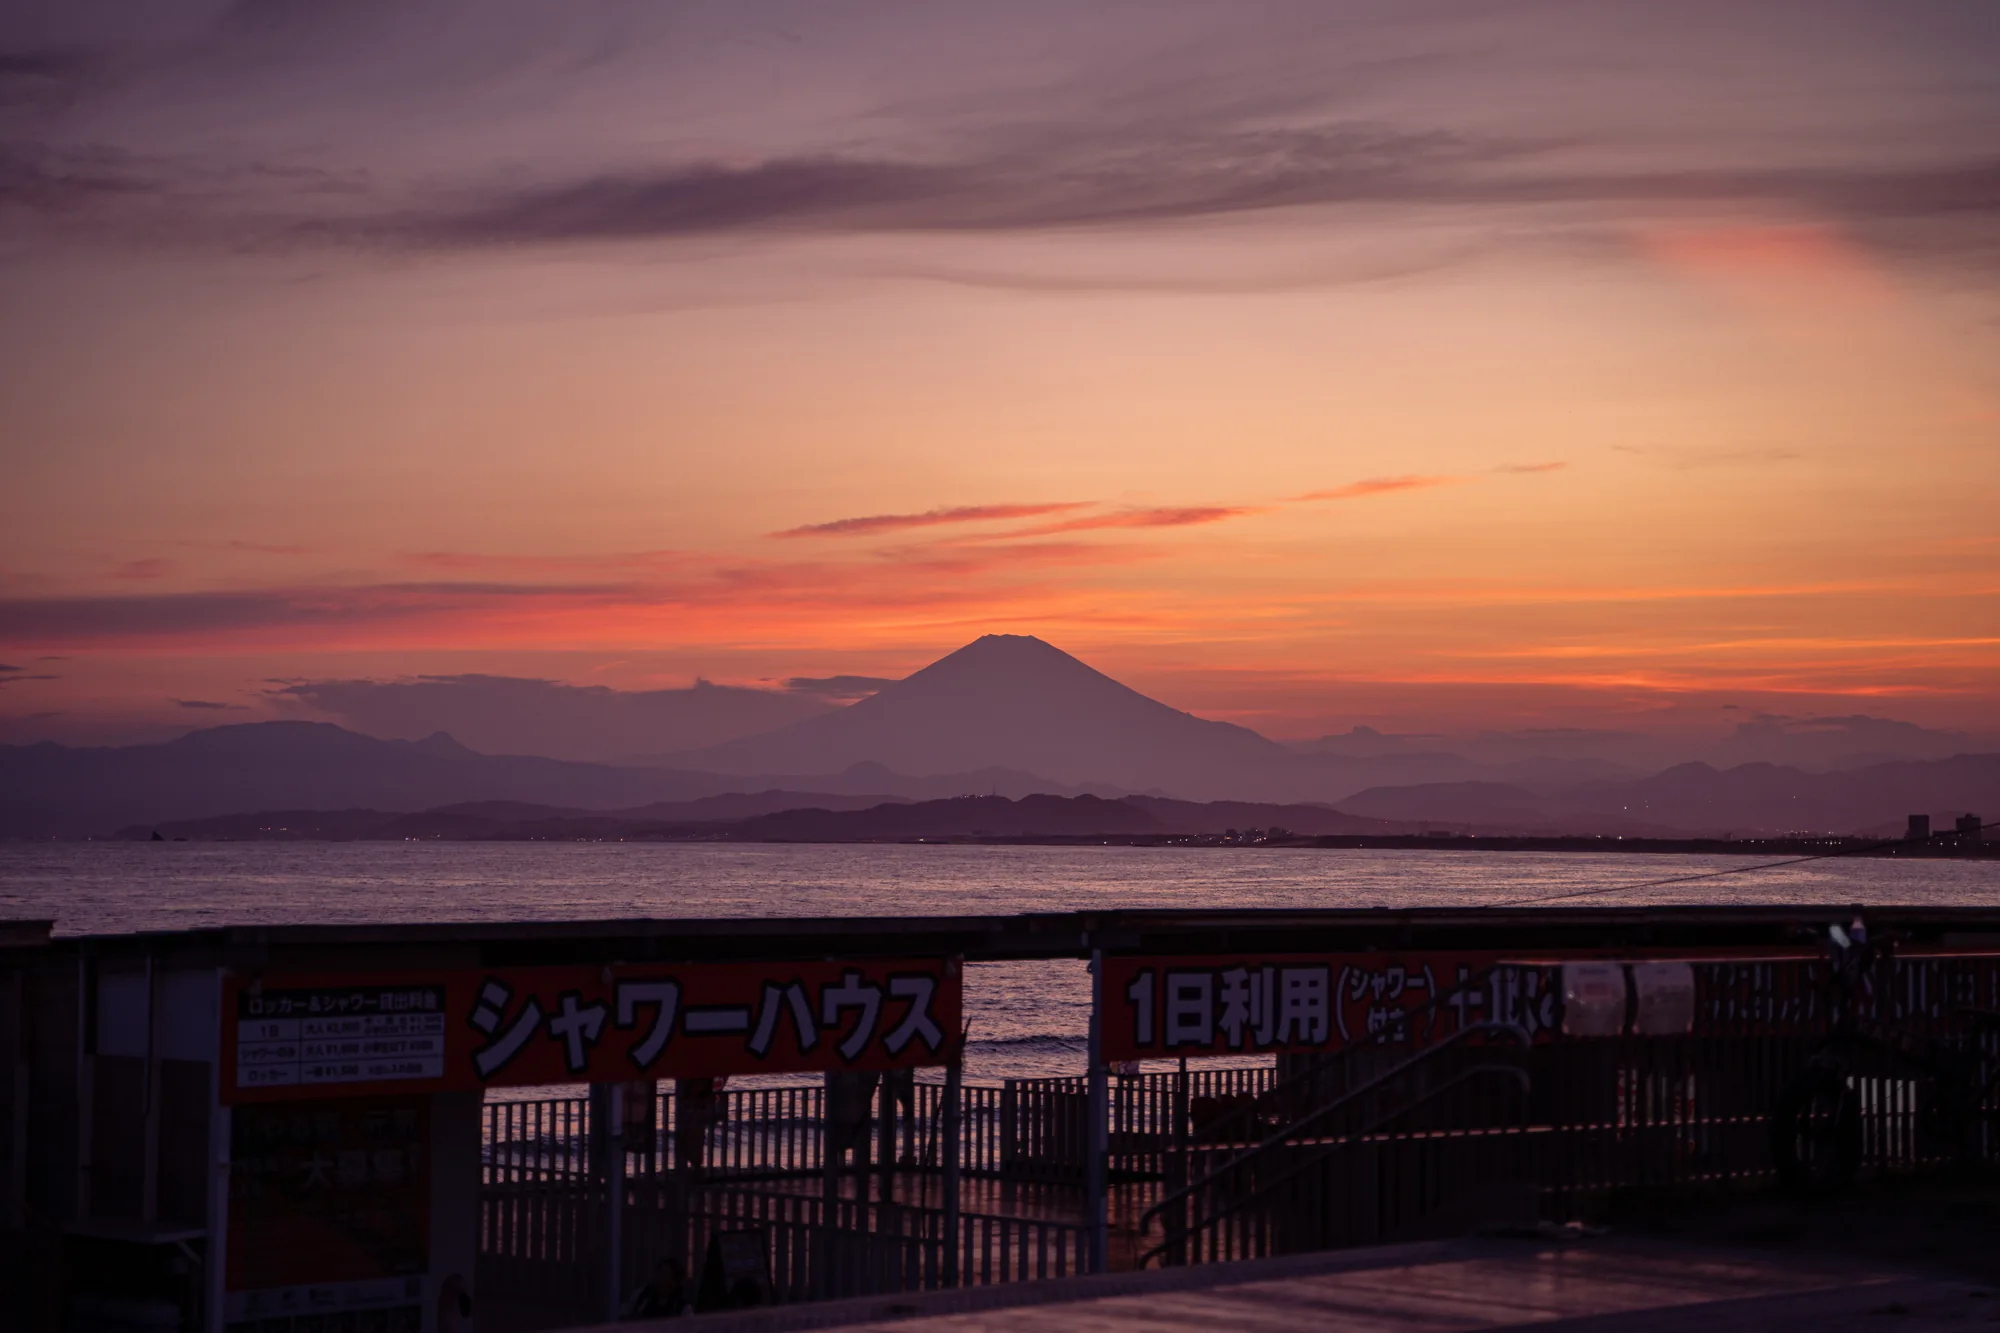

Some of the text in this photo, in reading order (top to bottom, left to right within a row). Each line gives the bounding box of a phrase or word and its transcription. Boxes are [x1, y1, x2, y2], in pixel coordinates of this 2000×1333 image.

[470, 971, 944, 1078] シャワーハウス
